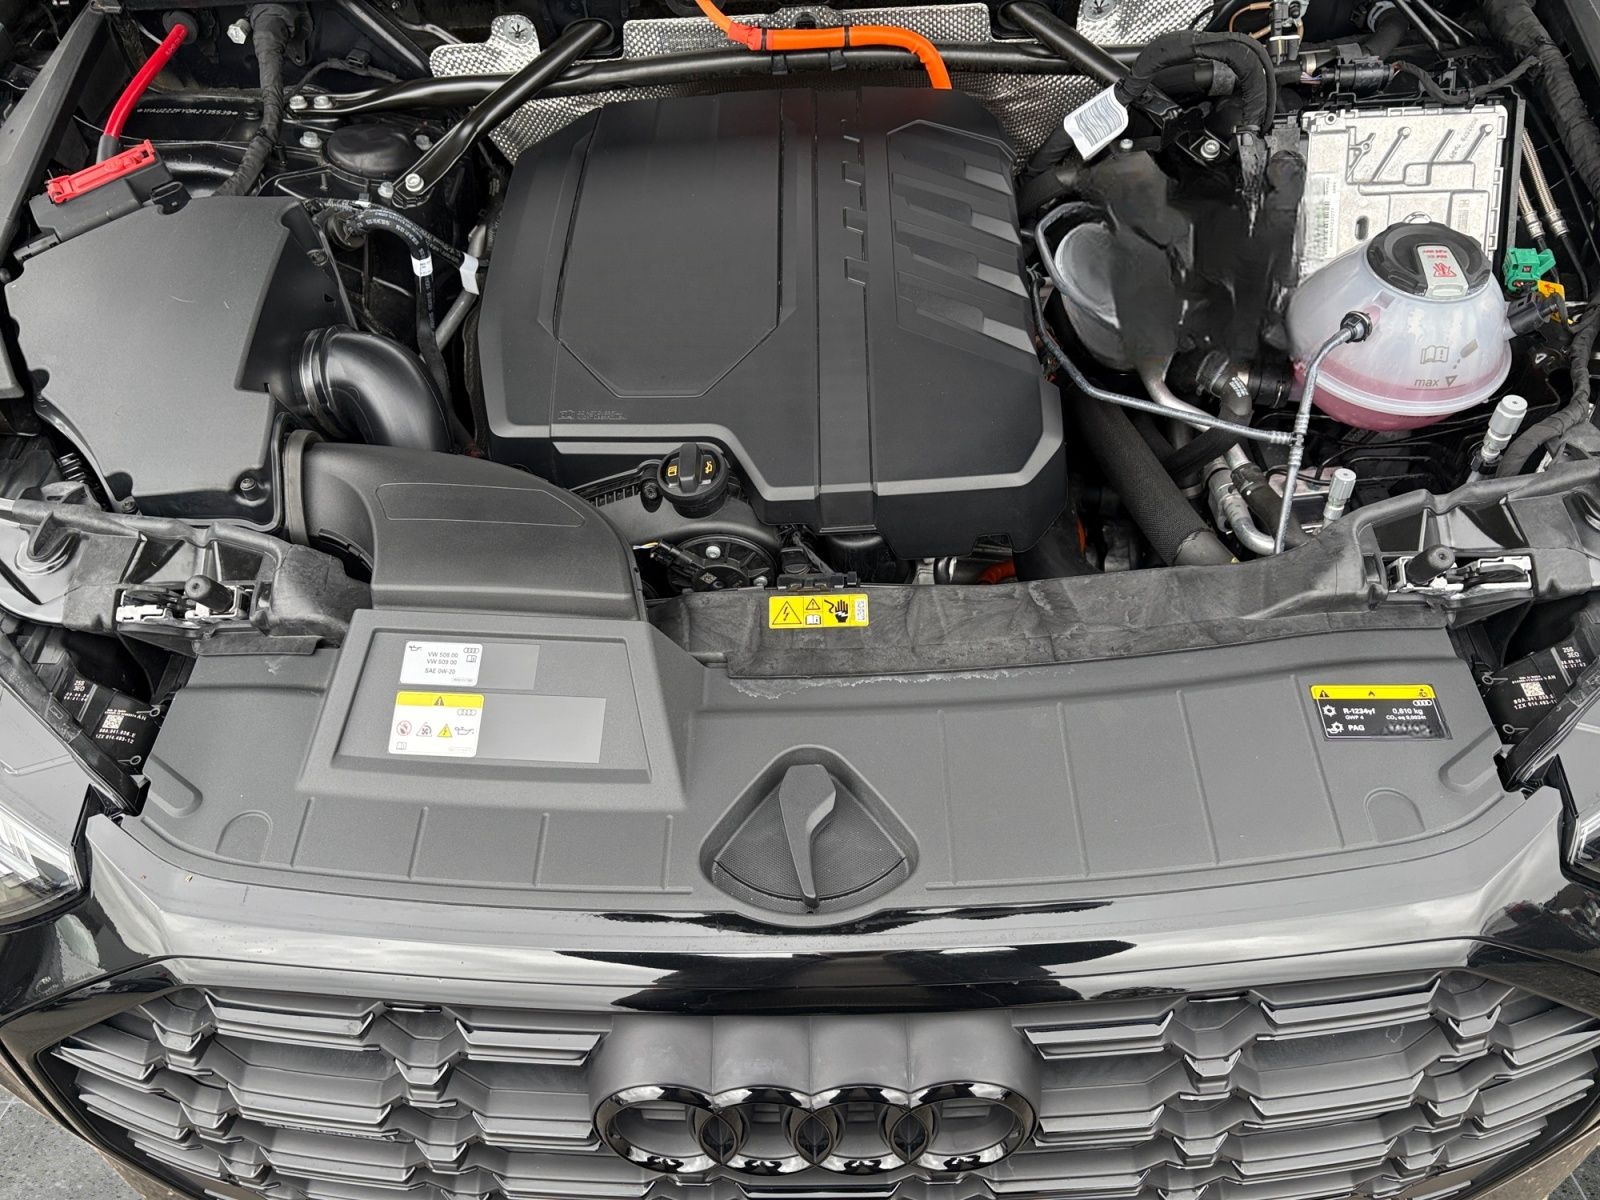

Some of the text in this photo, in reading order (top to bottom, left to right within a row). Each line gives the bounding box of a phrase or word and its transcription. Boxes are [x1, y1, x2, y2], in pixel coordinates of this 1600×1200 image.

[1414, 379, 1440, 387] max
[1342, 707, 1376, 715] R-1234yf
[1413, 707, 1424, 716] kg
